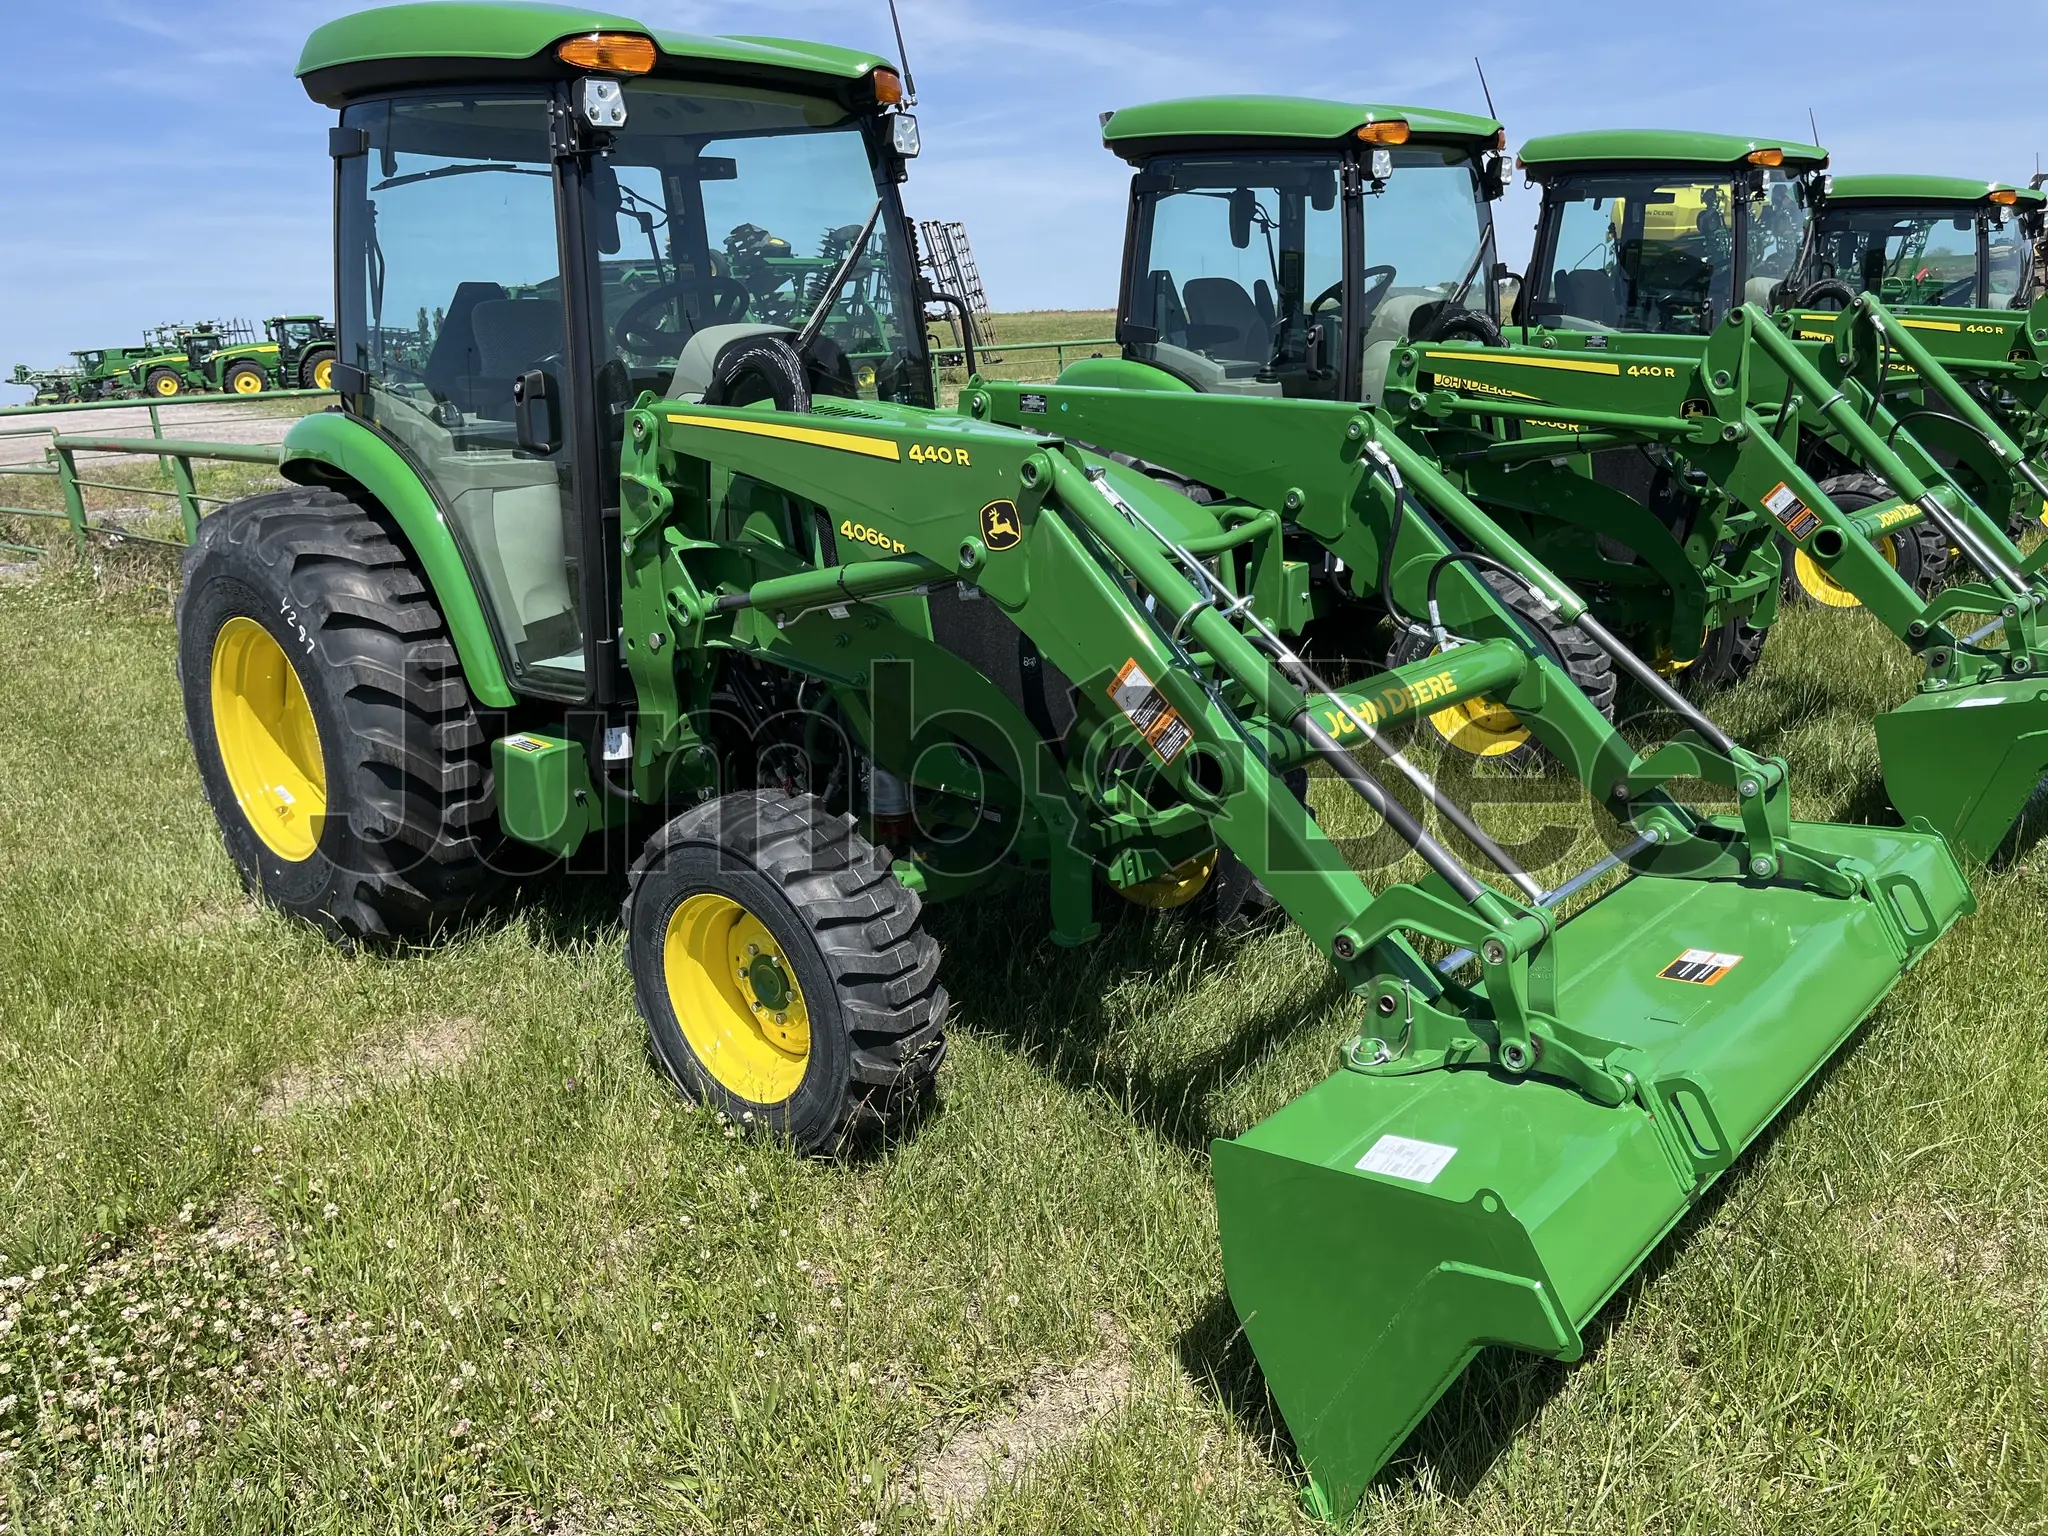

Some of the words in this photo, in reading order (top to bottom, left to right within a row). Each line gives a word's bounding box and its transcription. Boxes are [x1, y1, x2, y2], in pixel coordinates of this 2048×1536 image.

[1966, 324, 1993, 334] 440
[1995, 327, 2003, 335] R
[1627, 365, 1661, 378] 440
[1664, 367, 1675, 378] R
[1435, 375, 1468, 389] JOHN
[908, 443, 953, 464] 440
[955, 448, 971, 466] R
[1875, 509, 1903, 528] JOHN
[840, 520, 891, 550] 4066
[1324, 696, 1387, 740] JOHN
[1381, 670, 1458, 715] DEERE
